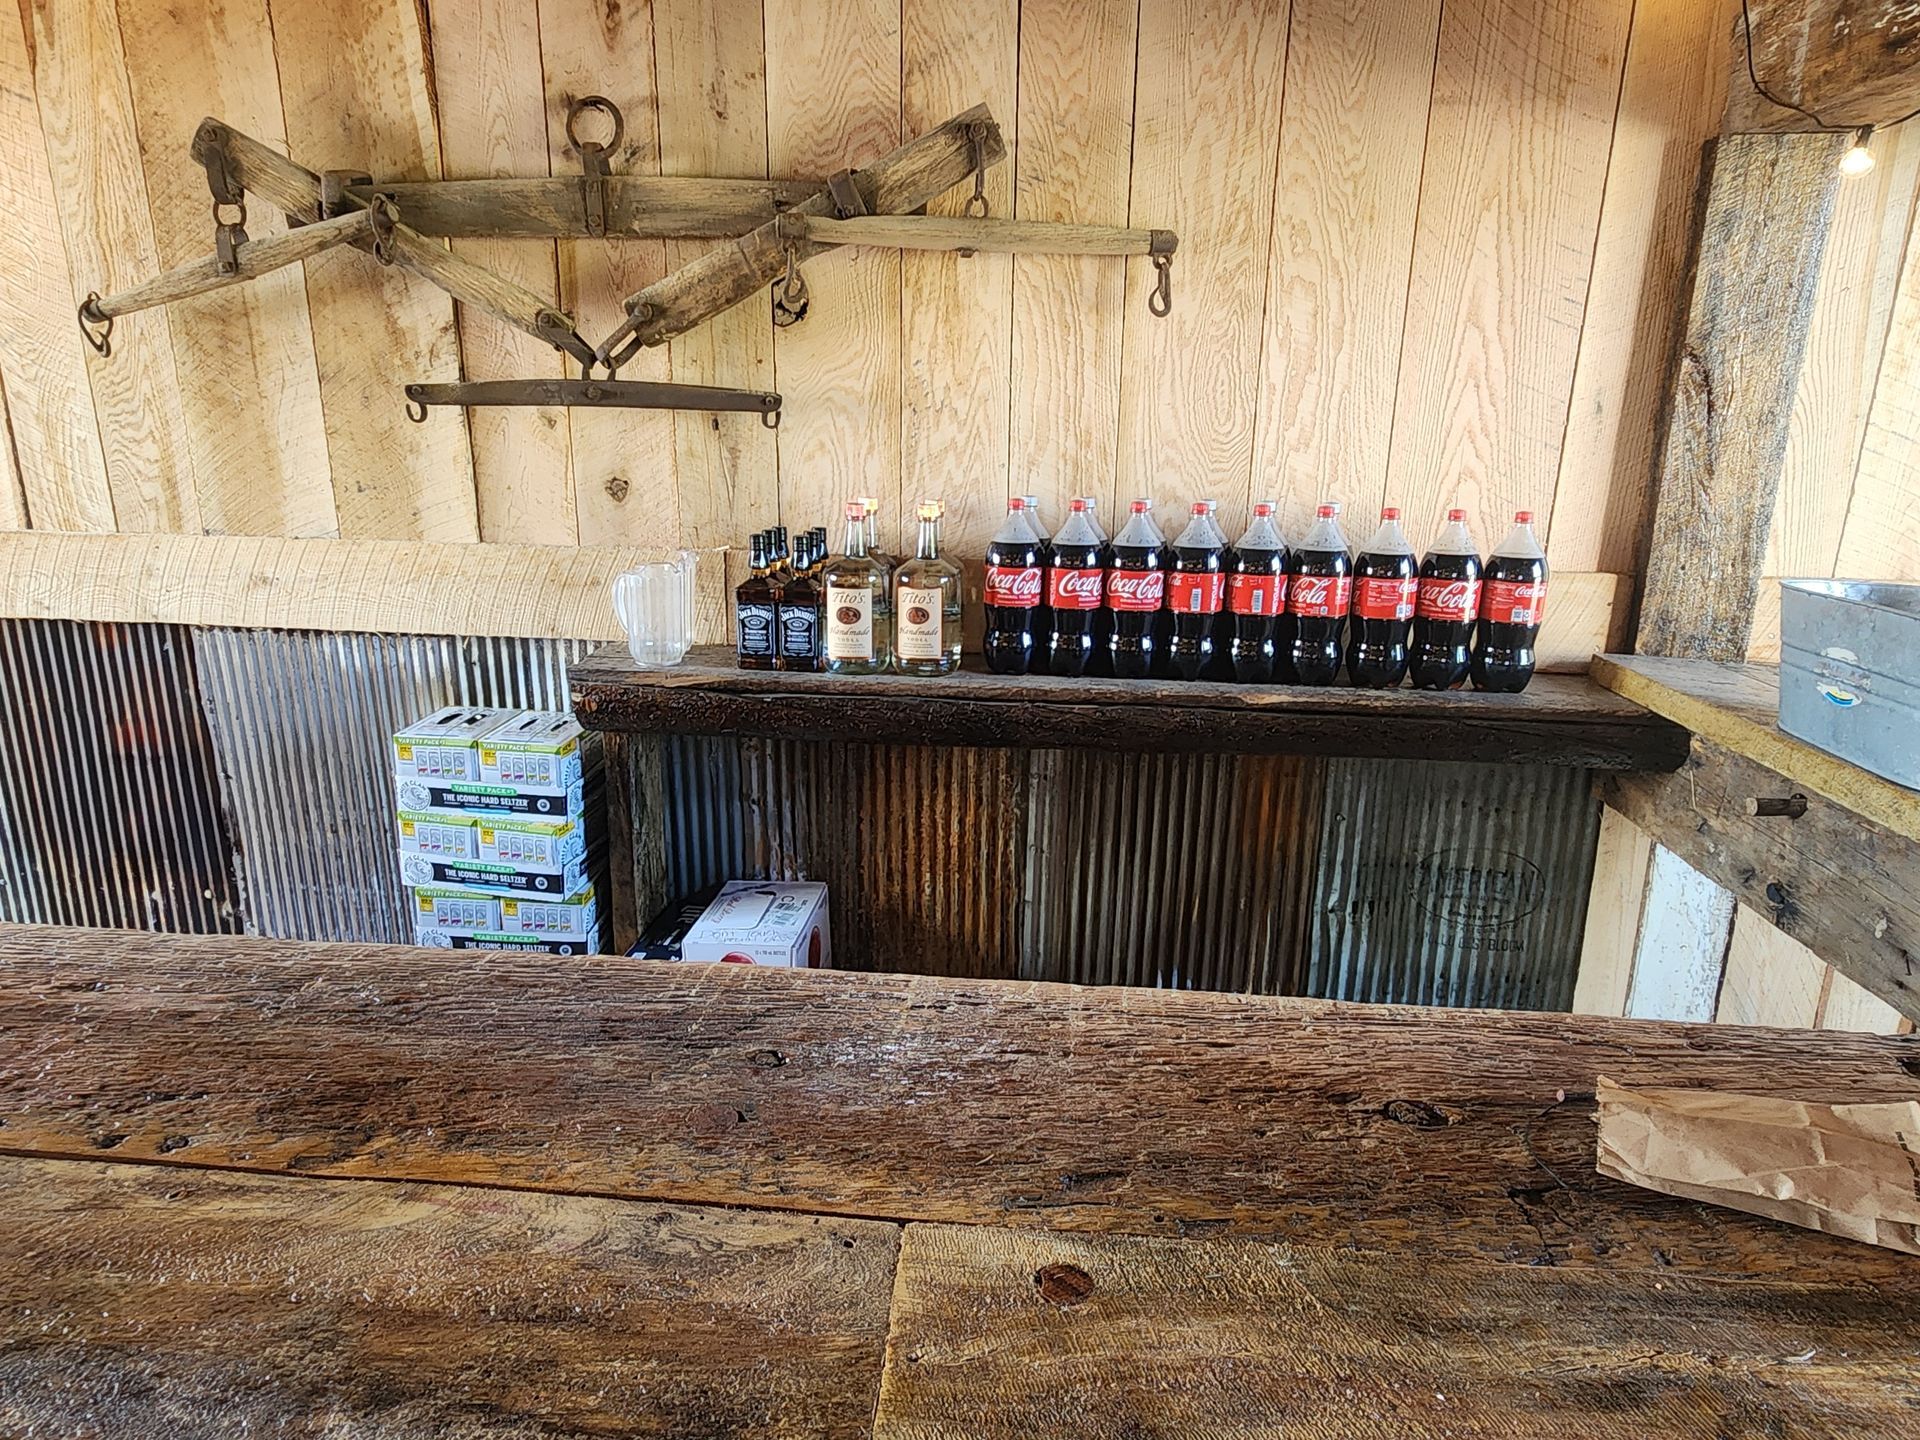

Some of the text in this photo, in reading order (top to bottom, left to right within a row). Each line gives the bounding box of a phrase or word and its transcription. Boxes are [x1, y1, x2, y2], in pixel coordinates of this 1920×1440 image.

[832, 591, 866, 604] Tito's
[902, 592, 935, 605] Tito's
[453, 784, 486, 793] VARIETY
[442, 793, 456, 801] THE
[456, 794, 480, 803] ICONIC
[481, 796, 500, 805] HARD
[500, 798, 528, 807] SELTZER
[445, 869, 457, 877] THE
[457, 870, 480, 879] ICONIC
[481, 872, 498, 881] HARD
[500, 875, 527, 884] SELTZER
[464, 941, 550, 953] THE ICONIC HARD SELTZER
